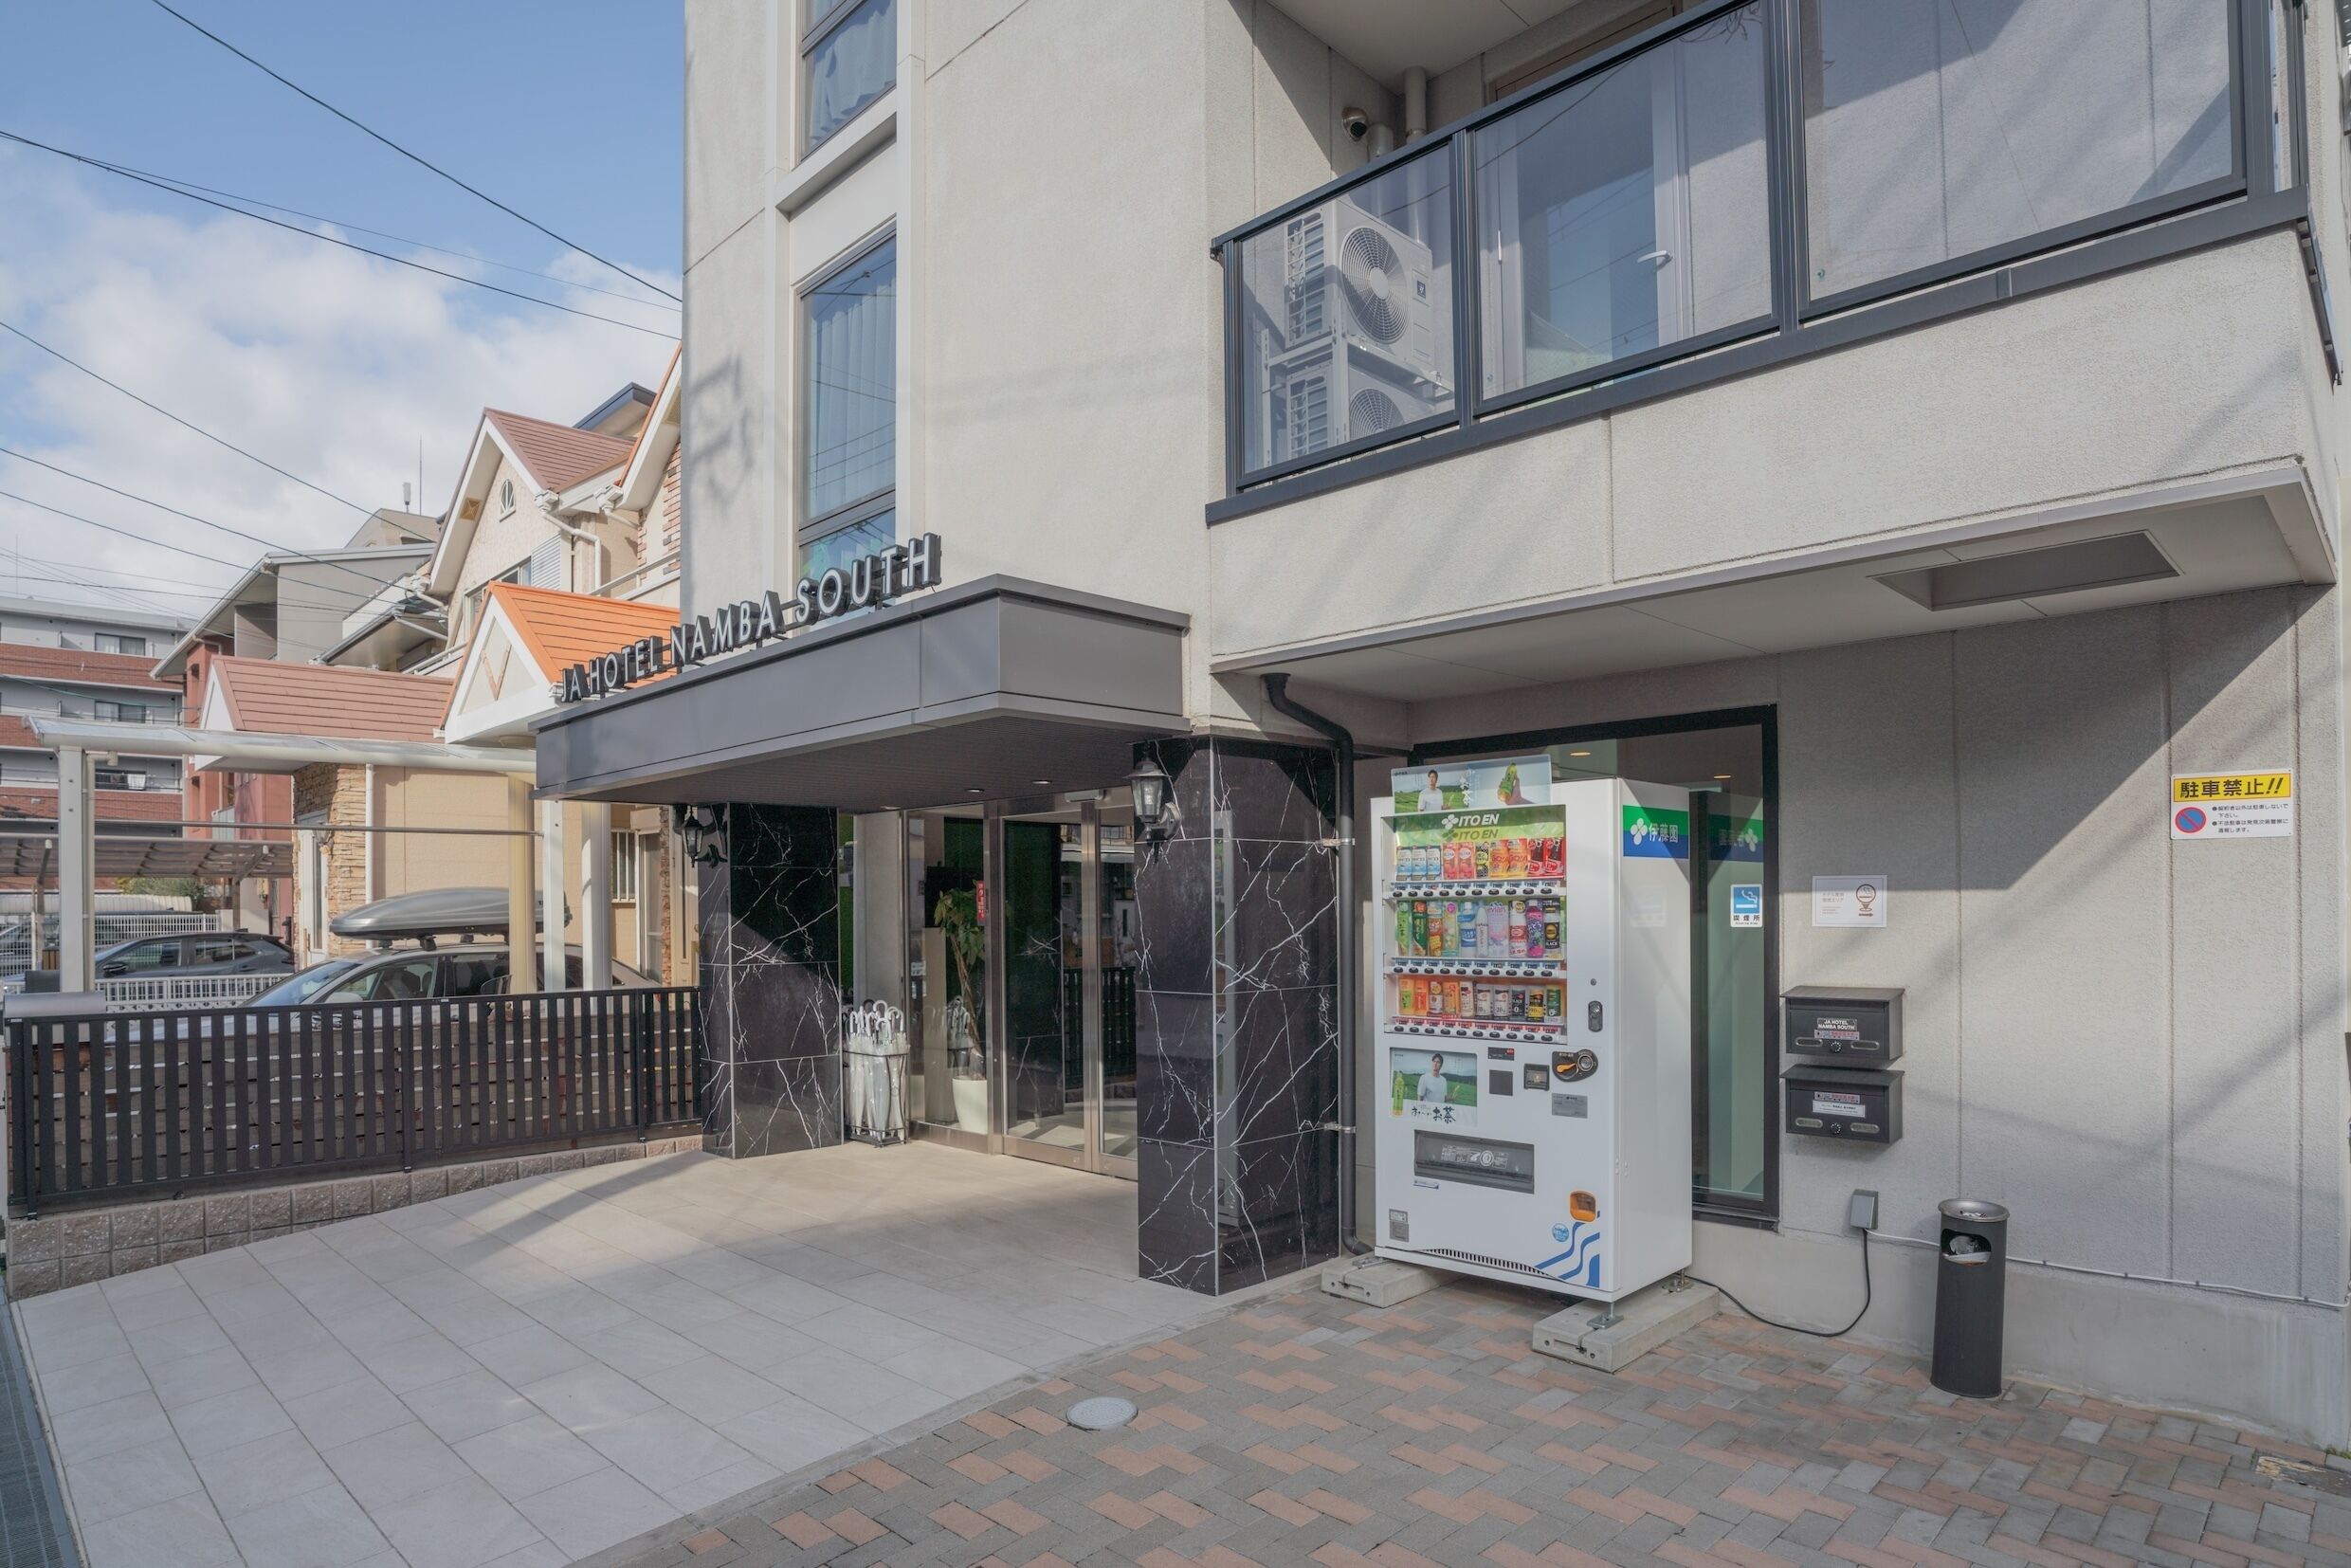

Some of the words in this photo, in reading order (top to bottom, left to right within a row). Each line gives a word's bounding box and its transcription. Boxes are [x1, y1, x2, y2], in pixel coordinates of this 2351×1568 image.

[561, 664, 589, 703] JA
[589, 635, 663, 695] HOTEL
[670, 590, 785, 665] NAMBA
[794, 532, 941, 626] SOUTH
[1458, 815, 1481, 828] ITO
[1482, 813, 1500, 826] EN
[1458, 830, 1481, 841] ITO
[1482, 829, 1499, 839] EN
[1649, 823, 1679, 843] 伊藤園
